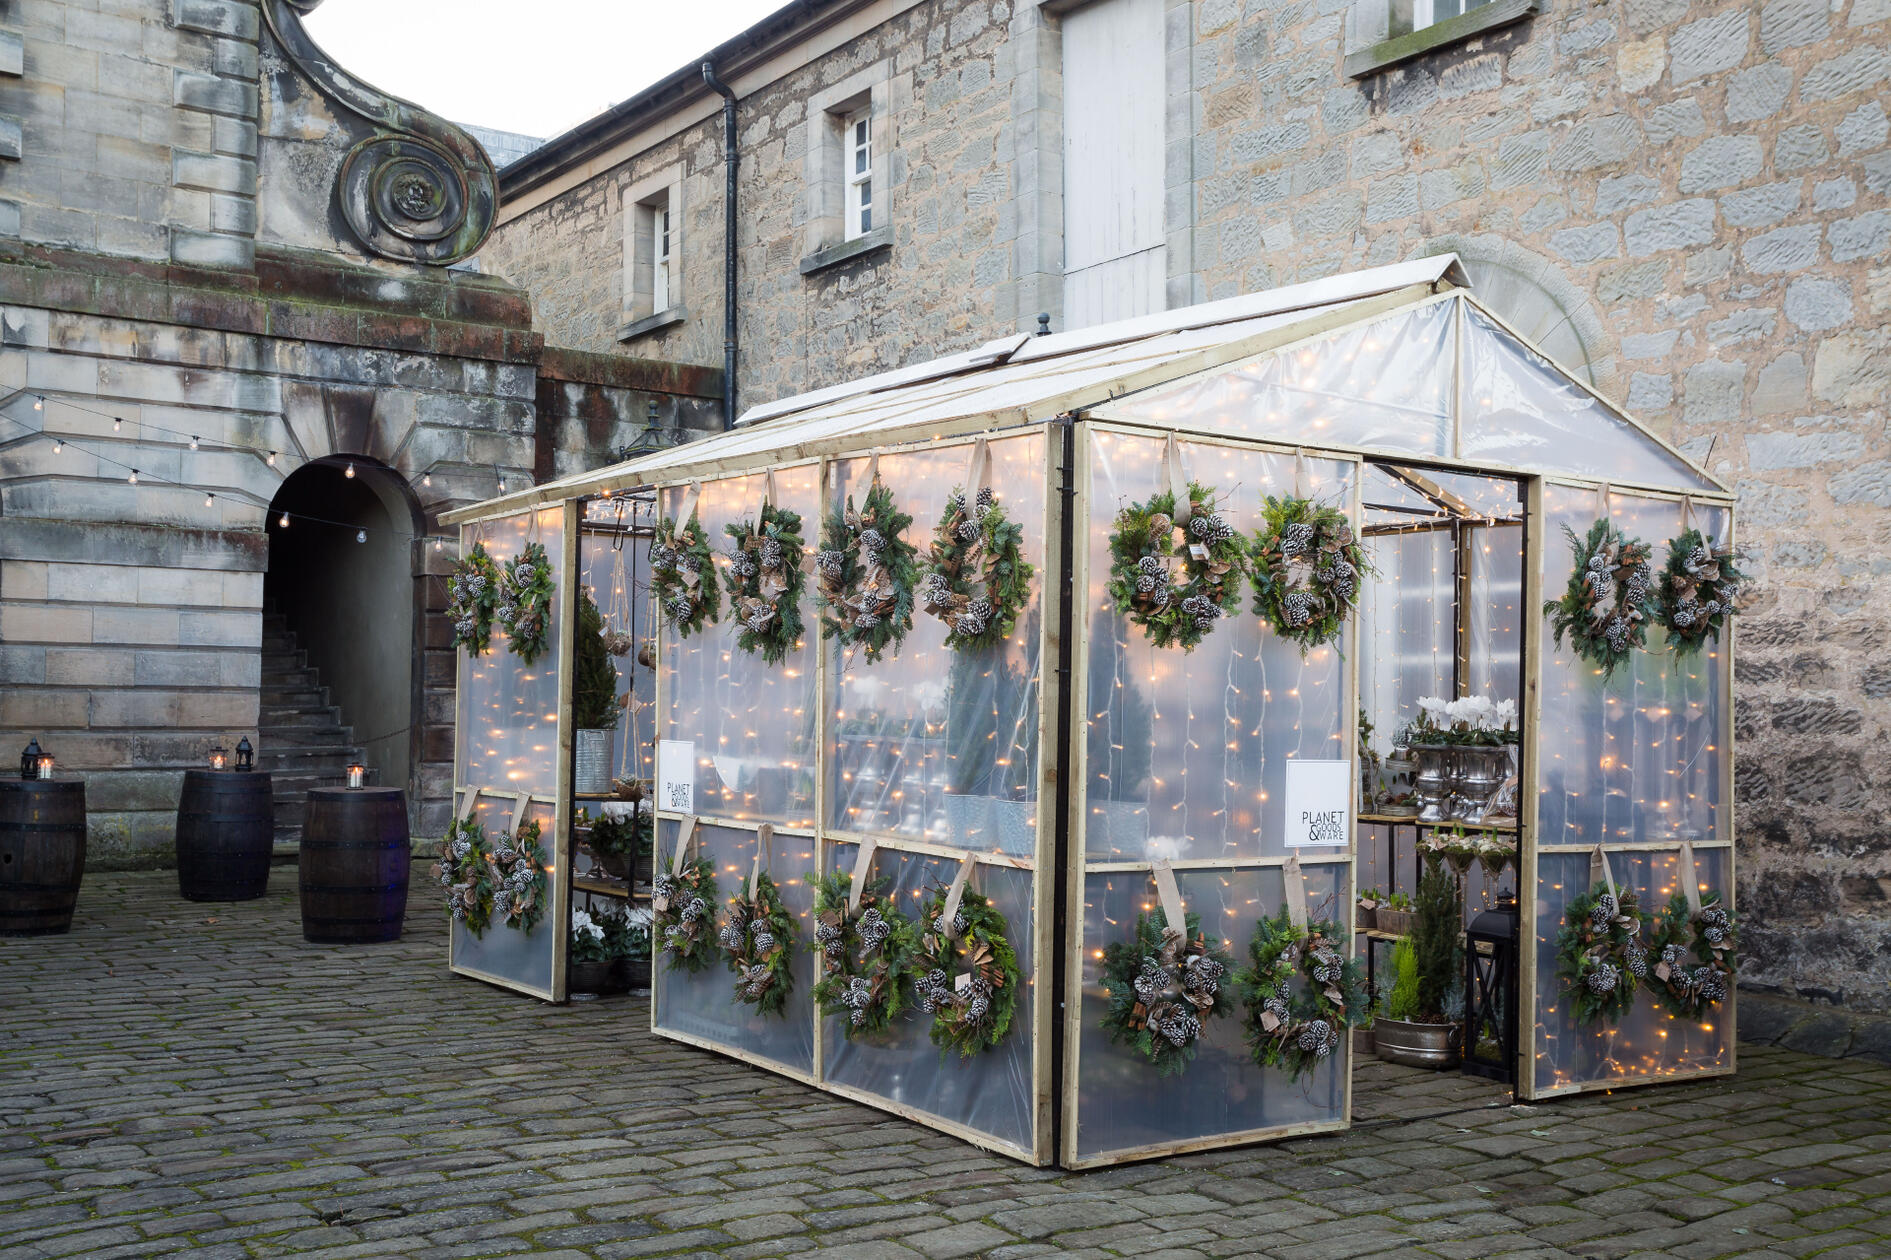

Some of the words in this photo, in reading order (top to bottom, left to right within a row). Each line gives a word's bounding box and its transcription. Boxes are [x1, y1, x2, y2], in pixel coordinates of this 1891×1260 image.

[667, 782, 690, 794] PLANET
[1302, 811, 1345, 824] PLANET
[1309, 824, 1319, 841] &
[1319, 831, 1344, 840] WARE
